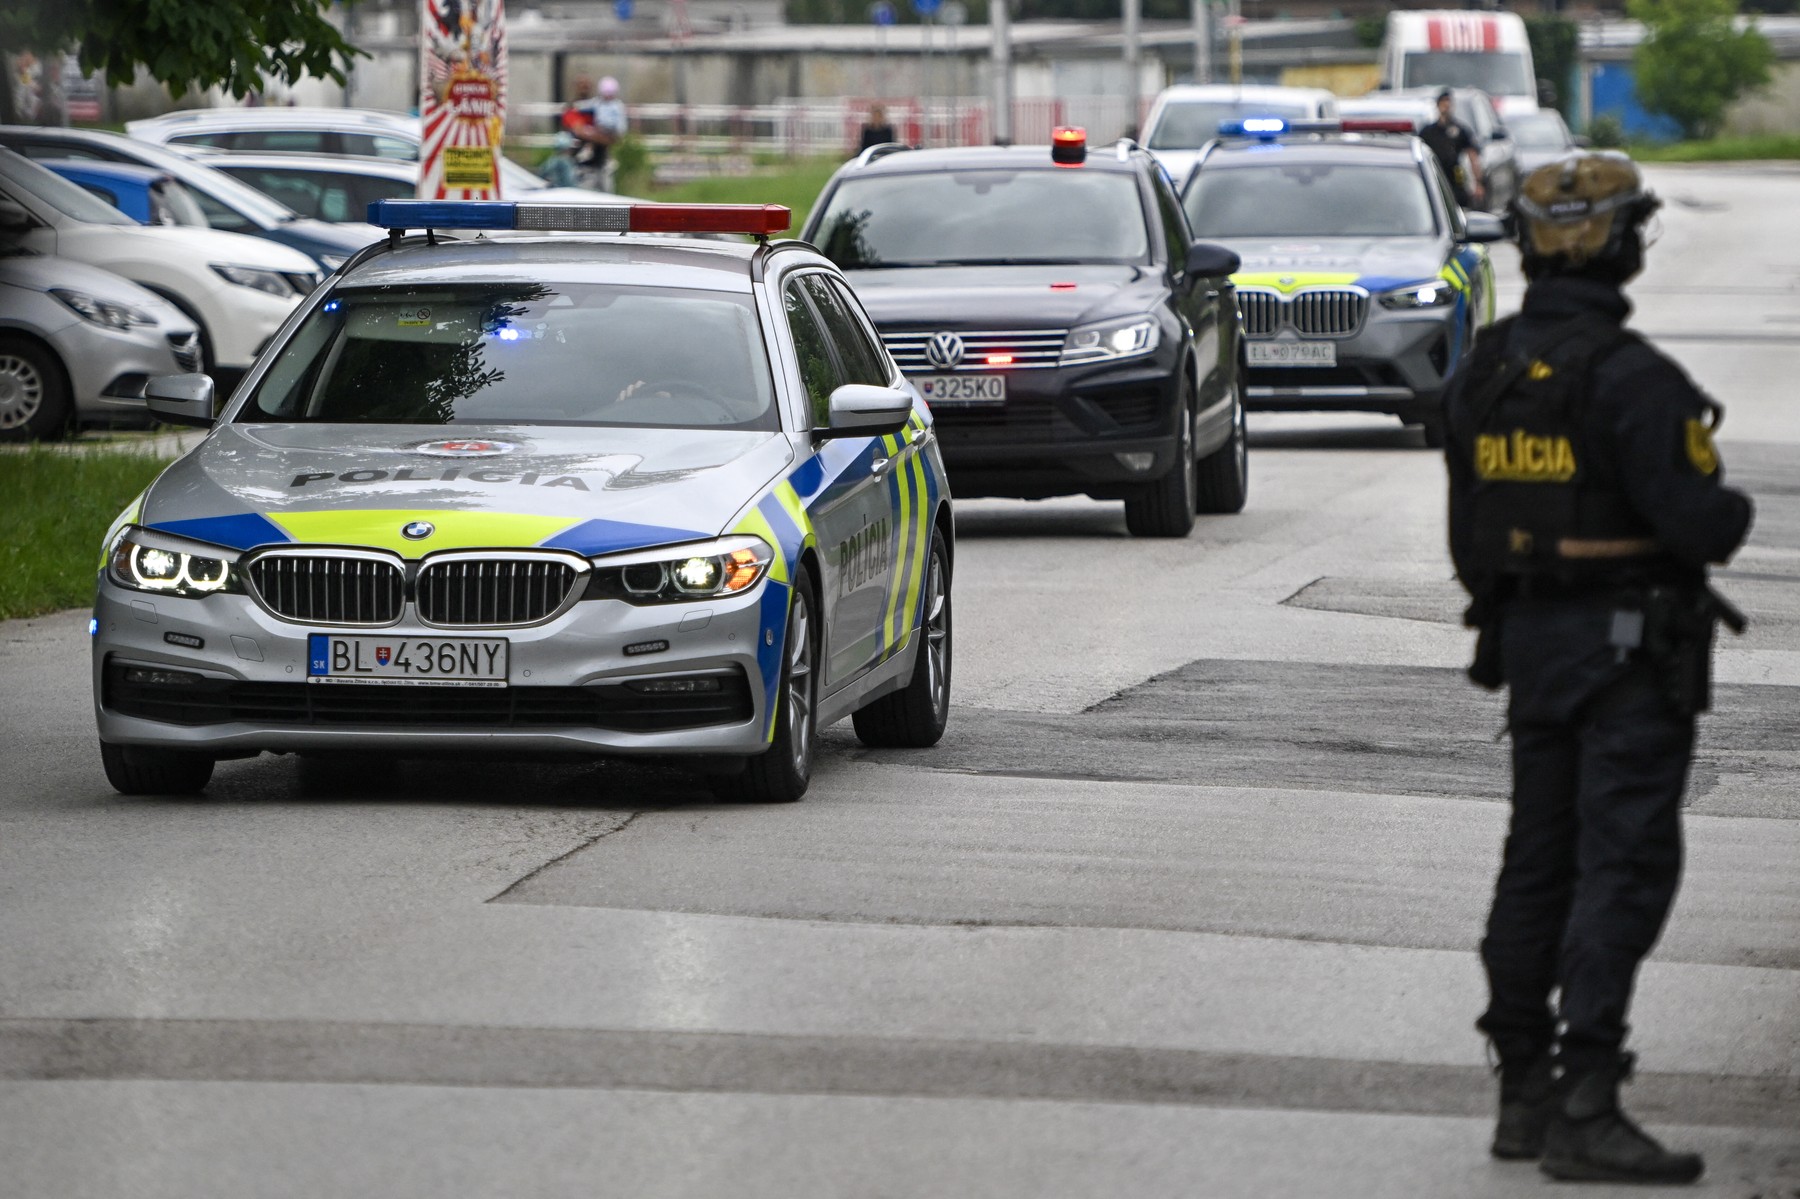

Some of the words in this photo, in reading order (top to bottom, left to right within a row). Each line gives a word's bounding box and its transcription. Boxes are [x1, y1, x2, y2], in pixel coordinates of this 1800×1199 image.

[839, 513, 888, 598] POLÍCIA
[313, 660, 326, 669] SK
[333, 640, 373, 672] BL
[393, 642, 500, 675] 436NY
